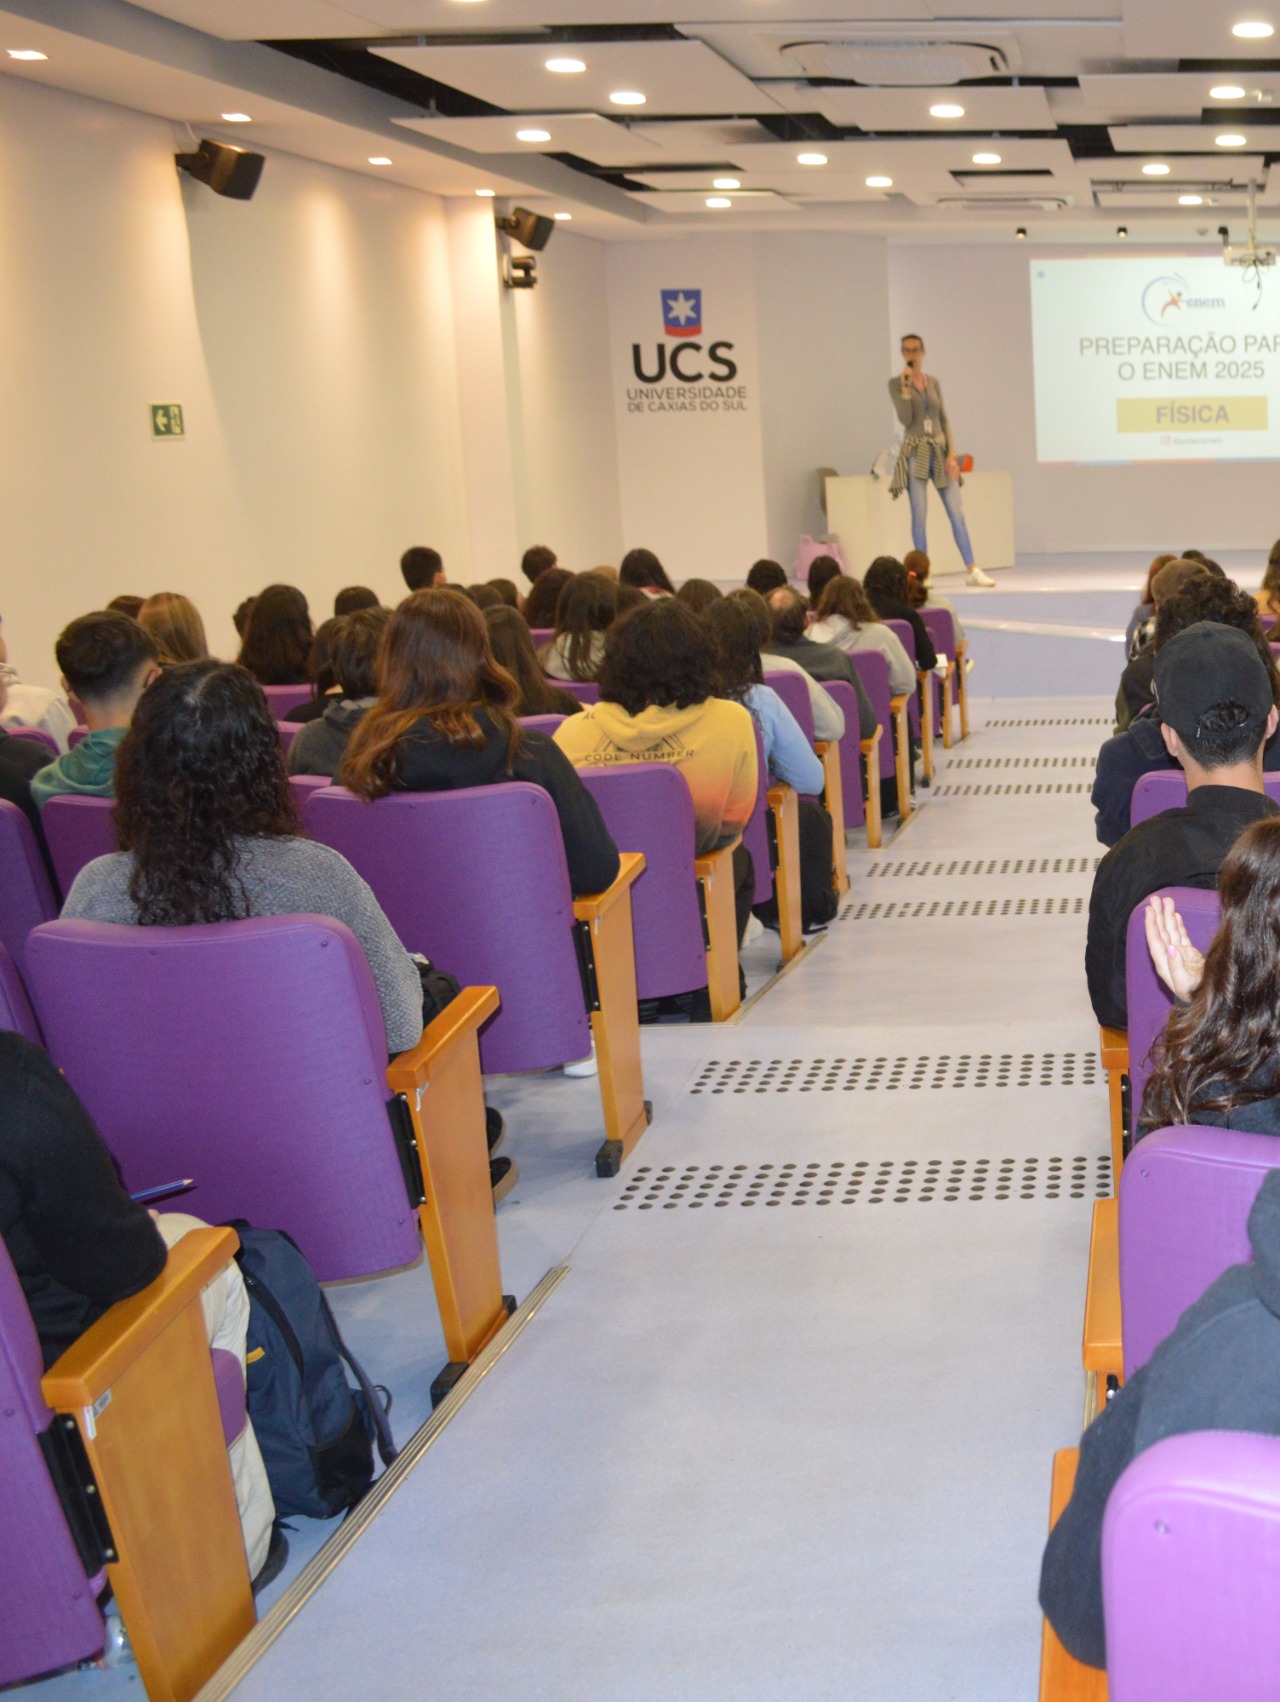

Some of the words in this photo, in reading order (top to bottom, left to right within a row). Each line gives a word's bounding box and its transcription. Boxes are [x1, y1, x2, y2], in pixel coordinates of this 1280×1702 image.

[1079, 332, 1237, 359] PREPARAÇÃO
[631, 341, 737, 384] UCS
[1117, 361, 1135, 381] O
[1143, 361, 1208, 381] ENEM
[1215, 360, 1265, 380] 2025
[626, 386, 748, 401] UNIVERSIDADE
[627, 402, 644, 413] DE
[647, 401, 697, 412] CAXIAS
[700, 401, 719, 411] DO
[723, 400, 748, 411] SUL
[1155, 400, 1231, 425] FÍSICA
[584, 753, 621, 762] CODE
[630, 749, 695, 762] NUMBER
